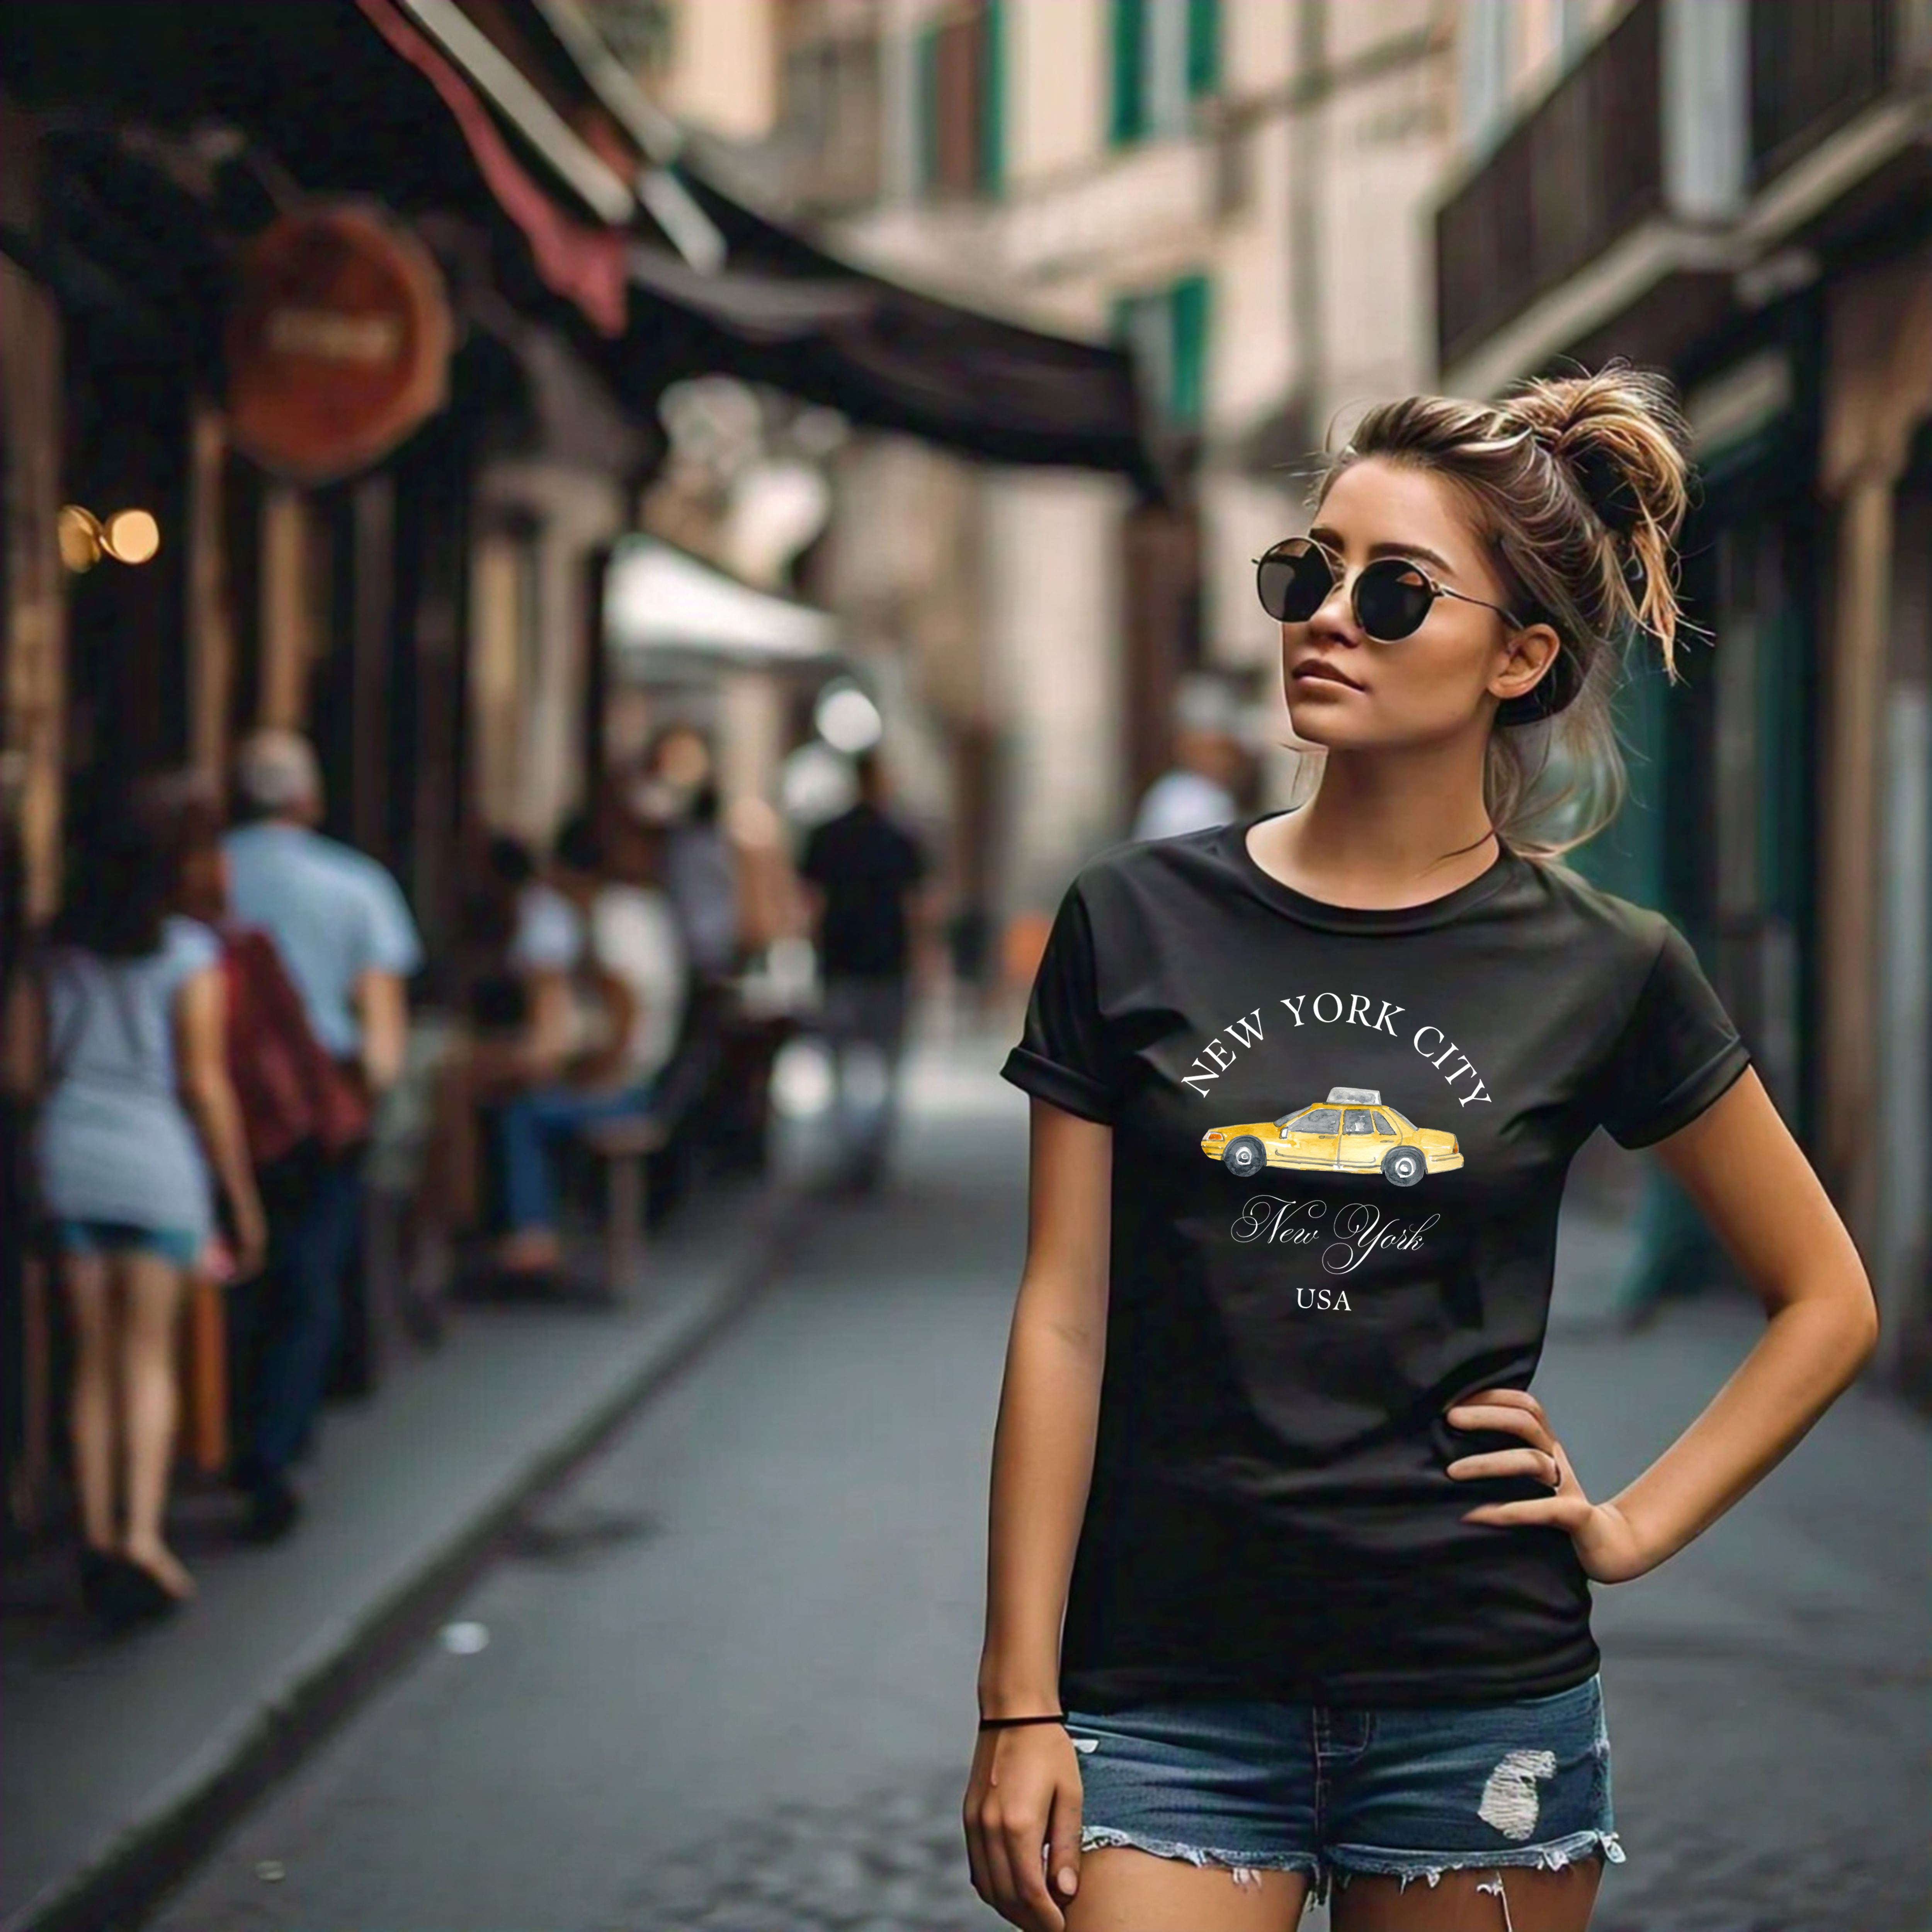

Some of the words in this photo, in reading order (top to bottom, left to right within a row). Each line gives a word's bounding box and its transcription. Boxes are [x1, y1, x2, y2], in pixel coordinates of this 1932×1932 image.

[1180, 1008, 1264, 1099] NEW
[1280, 992, 1406, 1037] YORK
[1413, 1026, 1492, 1108] CITY
[1231, 1194, 1327, 1244] New
[1322, 1203, 1441, 1275] York
[1296, 1287, 1352, 1311] USA
